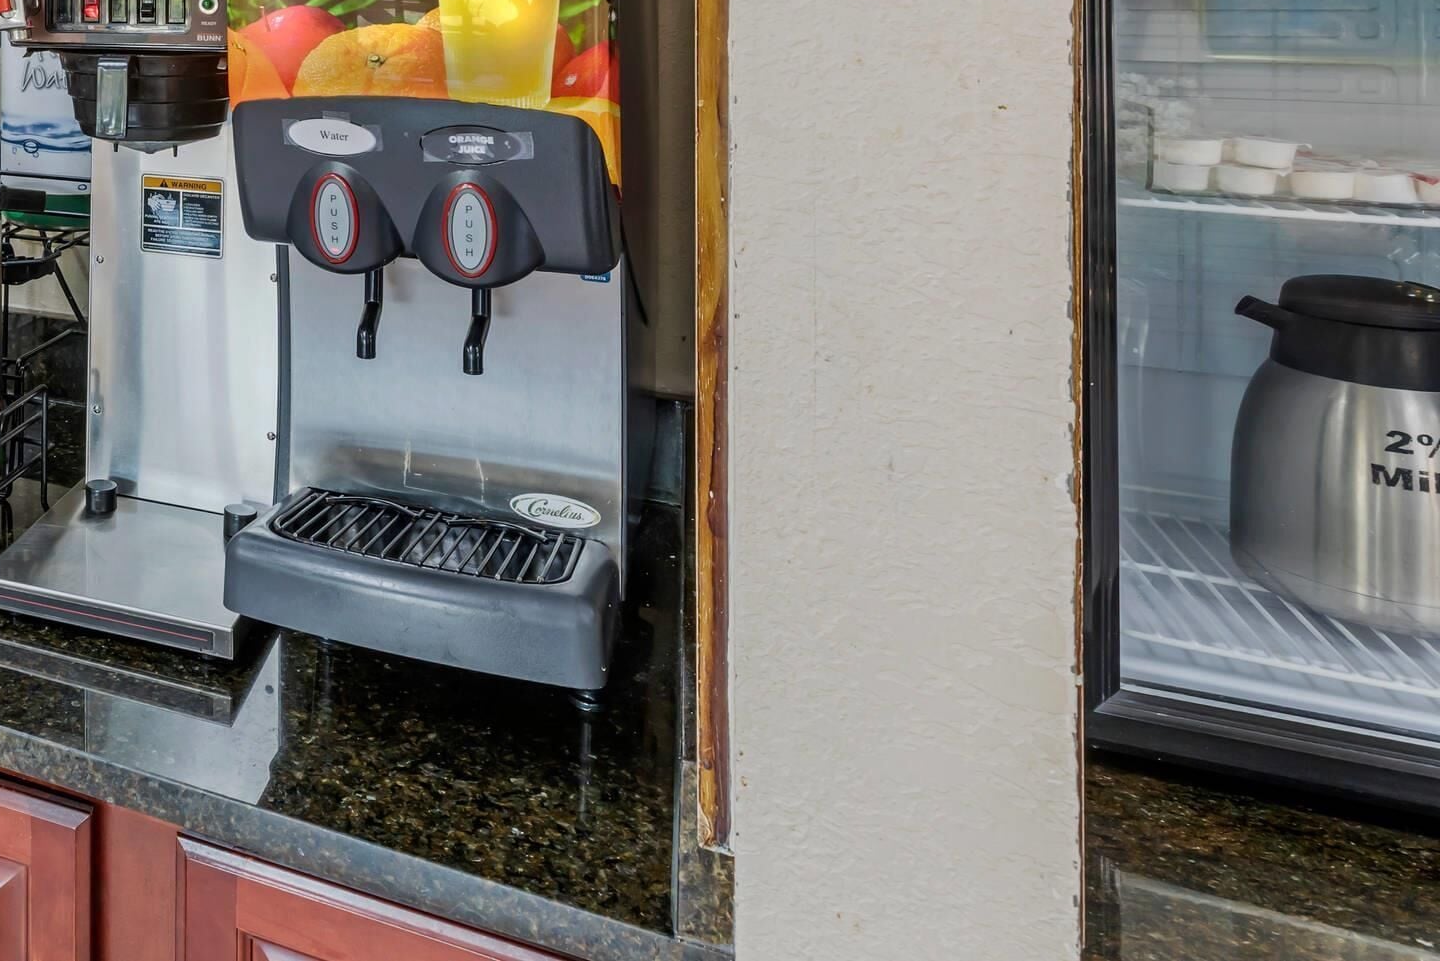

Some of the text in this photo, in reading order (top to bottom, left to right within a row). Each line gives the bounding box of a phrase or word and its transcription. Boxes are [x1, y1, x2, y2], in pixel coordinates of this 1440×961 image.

[196, 33, 222, 42] BUNN
[320, 130, 349, 142] Water
[448, 135, 495, 145] ORANGE
[458, 144, 487, 154] JUICE
[171, 181, 207, 191] WARNING
[330, 194, 339, 243] PUSH
[465, 205, 474, 257] PUSH
[527, 498, 583, 521] Cornelius
